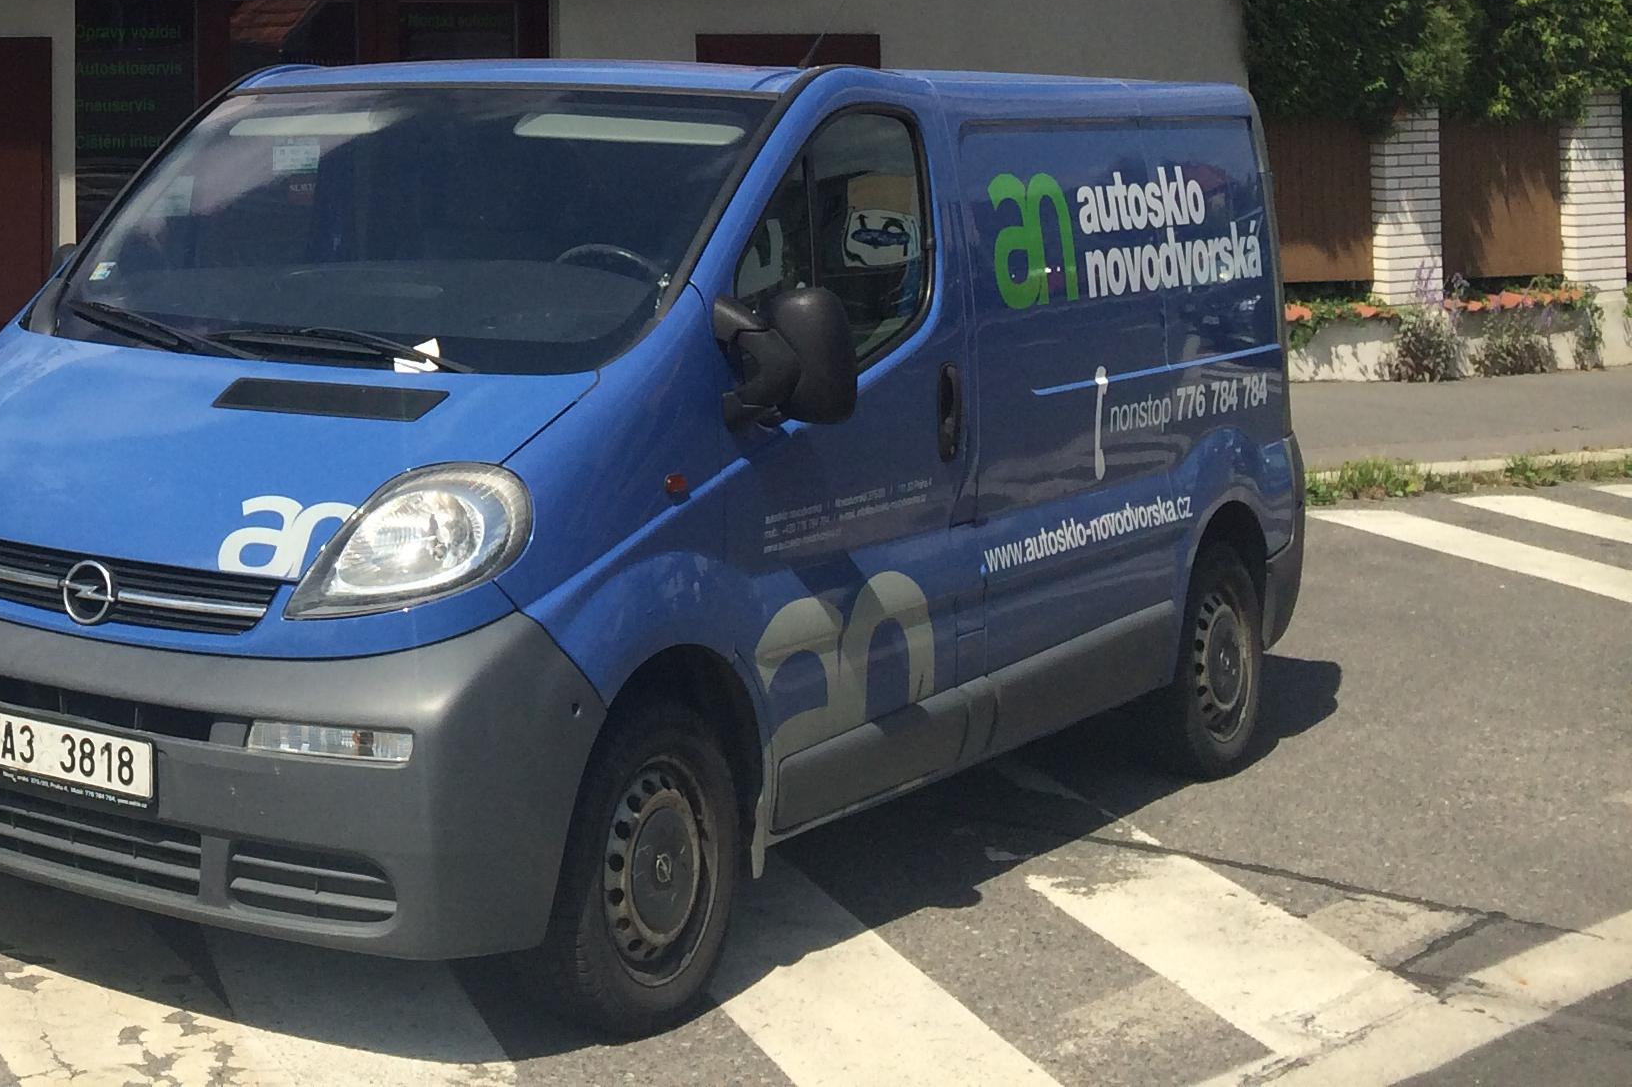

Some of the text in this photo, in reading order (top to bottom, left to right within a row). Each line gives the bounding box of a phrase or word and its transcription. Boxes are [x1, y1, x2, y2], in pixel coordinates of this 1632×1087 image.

[1077, 165, 1206, 234] autosklo
[1085, 217, 1262, 298] novodvorská
[1110, 374, 1268, 433] nonstop 776 784 784
[984, 495, 1193, 574] www.autosklo-novodvorska.cz
[59, 733, 134, 786] 3818
